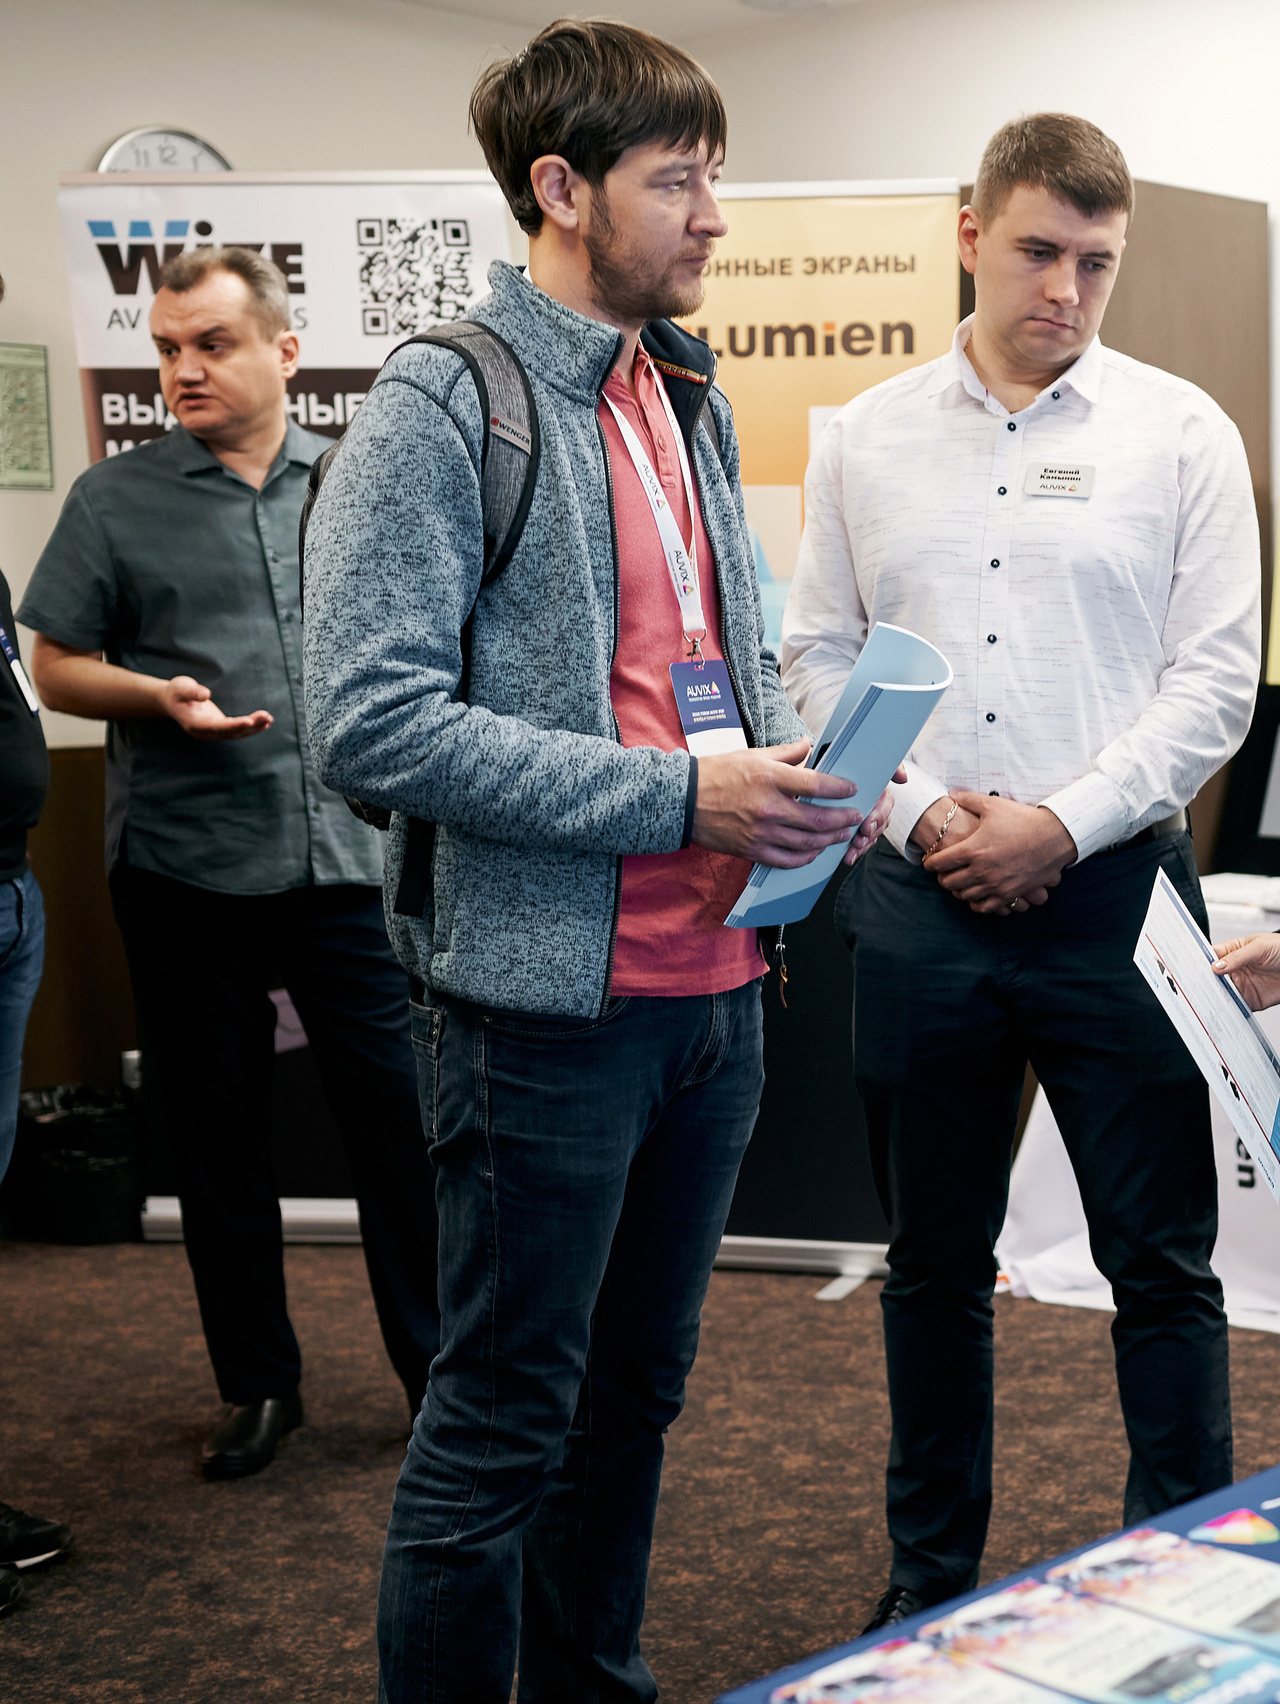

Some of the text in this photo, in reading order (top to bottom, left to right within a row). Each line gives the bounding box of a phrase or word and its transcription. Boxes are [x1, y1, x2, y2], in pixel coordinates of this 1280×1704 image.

[159, 146, 177, 166] 12
[802, 254, 916, 275] ЭКРАНЫ
[107, 308, 141, 330] AV
[499, 421, 531, 446] WENGER
[642, 463, 661, 496] AUVIX
[1039, 483, 1067, 491] AUVIX
[673, 549, 690, 583] AUVIX
[686, 683, 712, 697] AUVIX
